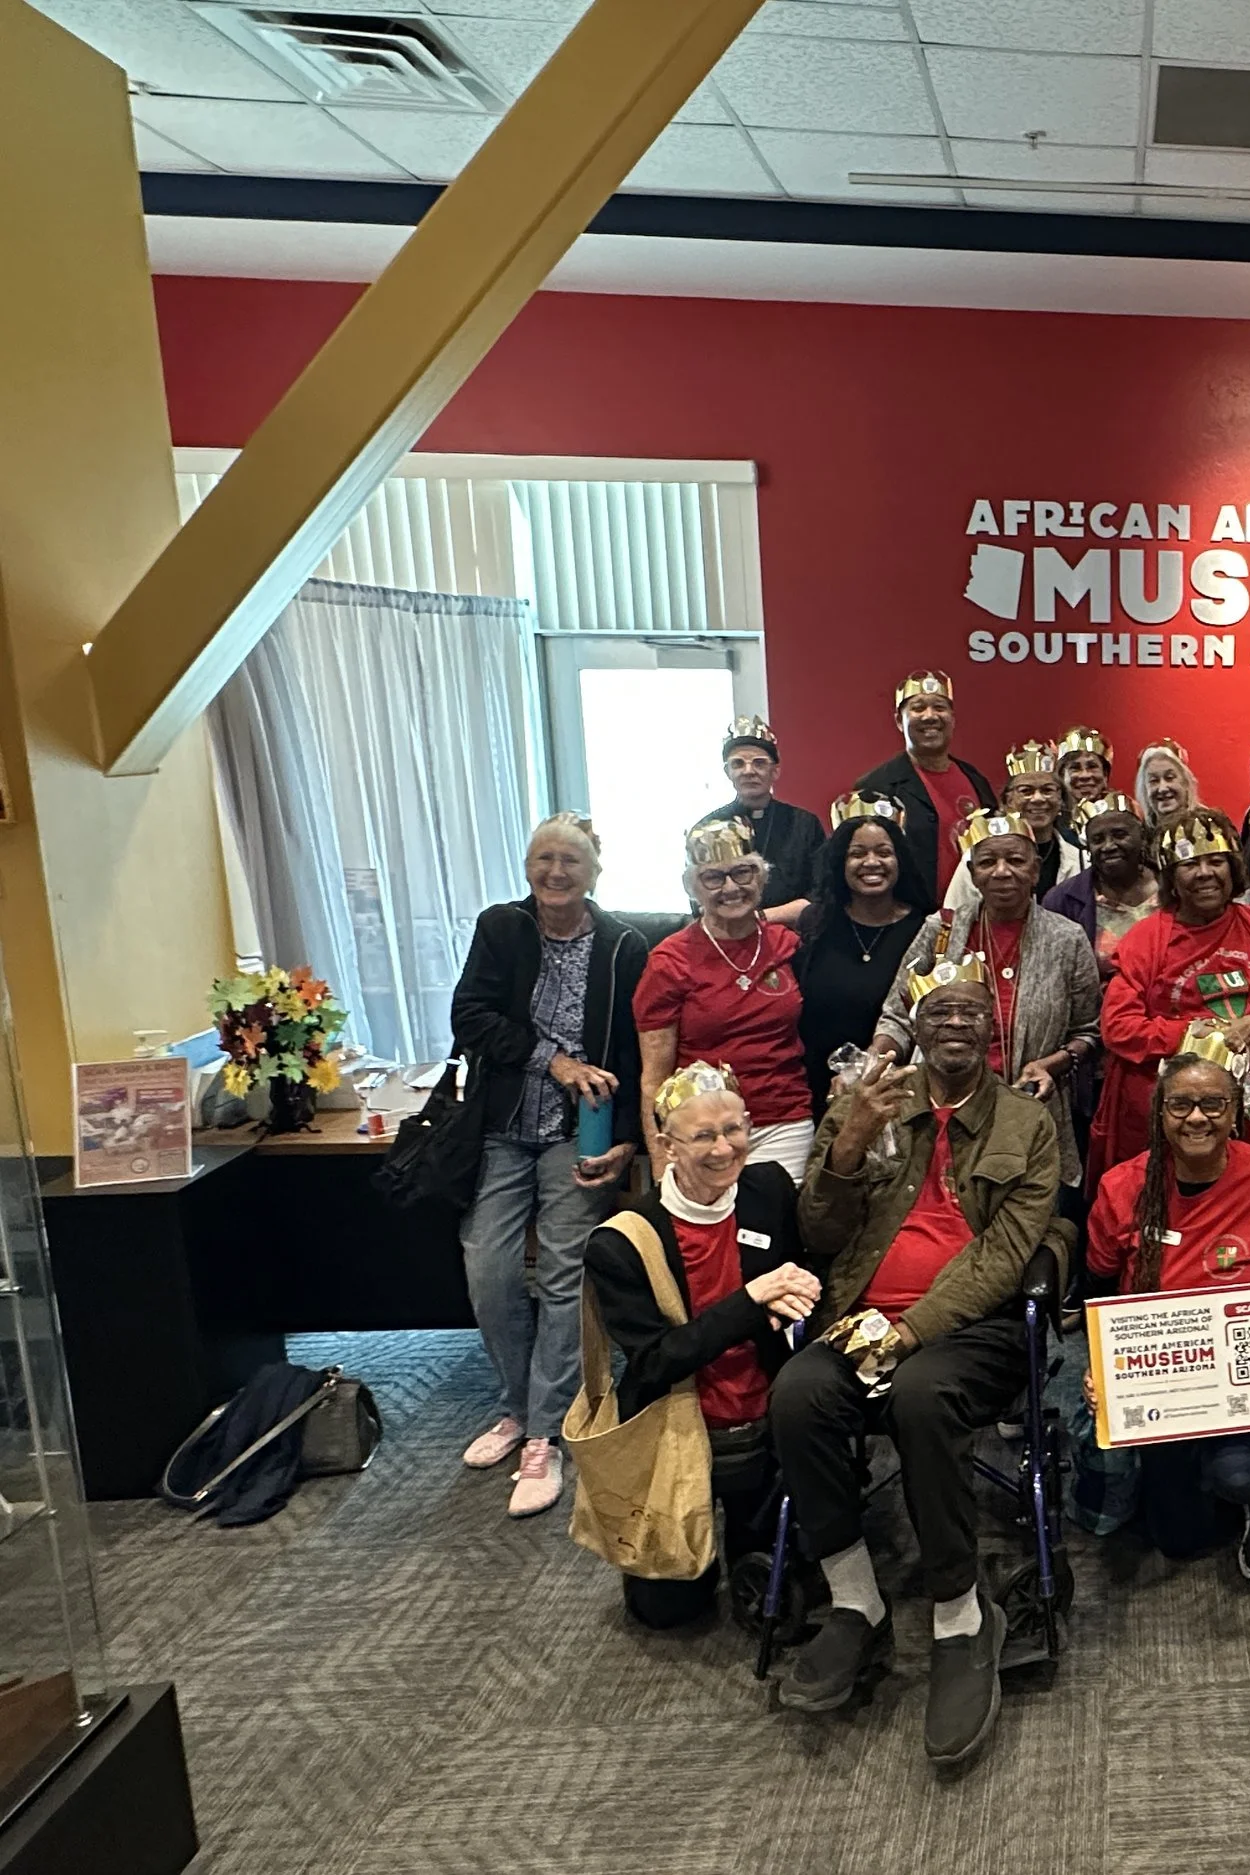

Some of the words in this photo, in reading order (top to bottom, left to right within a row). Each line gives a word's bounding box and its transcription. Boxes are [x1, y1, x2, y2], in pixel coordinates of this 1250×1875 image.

[966, 499, 1190, 541] AFRICAN
[968, 631, 1235, 667] SOUTHERN
[1109, 1321, 1157, 1333] AMERICAN
[1159, 1317, 1198, 1327] MUSEUM
[1201, 1315, 1213, 1323] OF
[1110, 1314, 1149, 1325] VISITING
[1150, 1312, 1168, 1320] THE
[1171, 1308, 1211, 1318] AFRICAN
[1114, 1328, 1164, 1341] SOUTHERN
[1166, 1324, 1210, 1335] ARIZONA!
[1114, 1344, 1157, 1355] AFRICAN
[1161, 1338, 1214, 1350] AMERICAN
[1126, 1346, 1215, 1370] MUSEUM
[1115, 1368, 1169, 1380] SOUTHERN
[1172, 1363, 1216, 1374] ARIZONA
